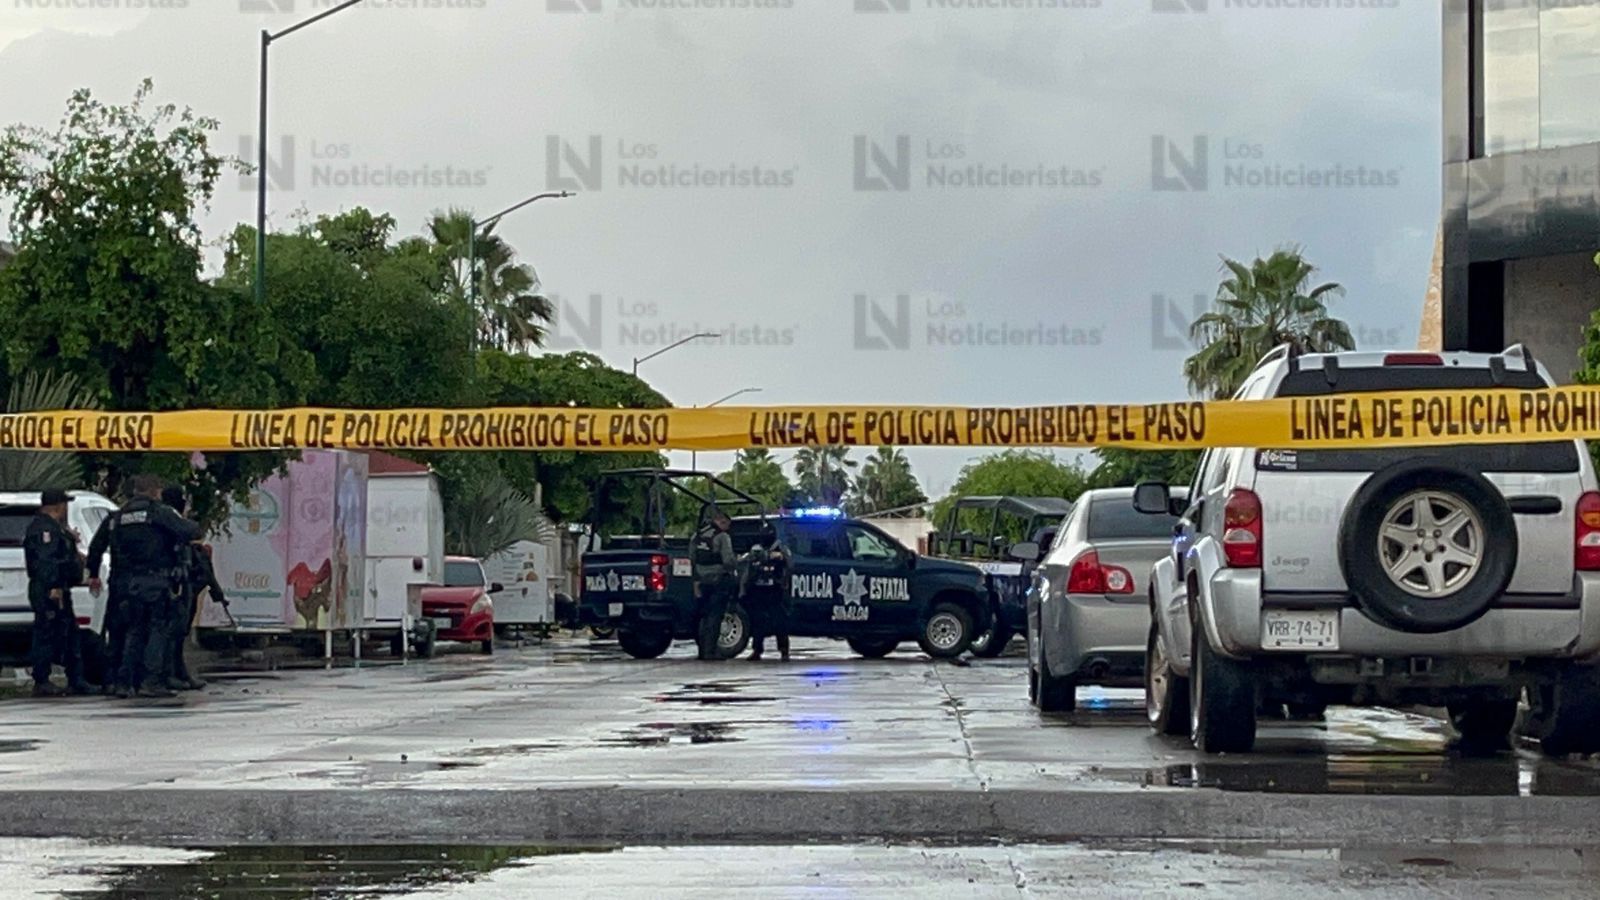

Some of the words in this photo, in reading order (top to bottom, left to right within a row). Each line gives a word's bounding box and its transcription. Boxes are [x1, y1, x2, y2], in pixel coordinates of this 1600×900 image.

[0, 416, 53, 448] BIDO
[60, 416, 87, 448] EL
[95, 415, 153, 449] PASO
[231, 413, 297, 448] LINEA
[304, 413, 336, 447] DE
[343, 412, 432, 447] POLICIA
[439, 412, 567, 447] PROHIBIDO
[574, 413, 602, 446] EL
[608, 413, 668, 446] PASO
[750, 411, 818, 445] LINEA
[826, 411, 857, 445] DE
[864, 409, 960, 445] POLICIA
[966, 404, 1098, 444] PROHIBIDO
[1106, 404, 1136, 441] EL
[1144, 401, 1206, 441] PASO
[1291, 398, 1364, 440] LINEA
[1372, 397, 1404, 438] DE
[1411, 394, 1511, 437] POLICIA
[1520, 391, 1600, 433] PROHI
[791, 572, 834, 598] POLICÍA
[870, 577, 910, 601] ESTATAL
[1267, 620, 1333, 636] VRR-74-71
